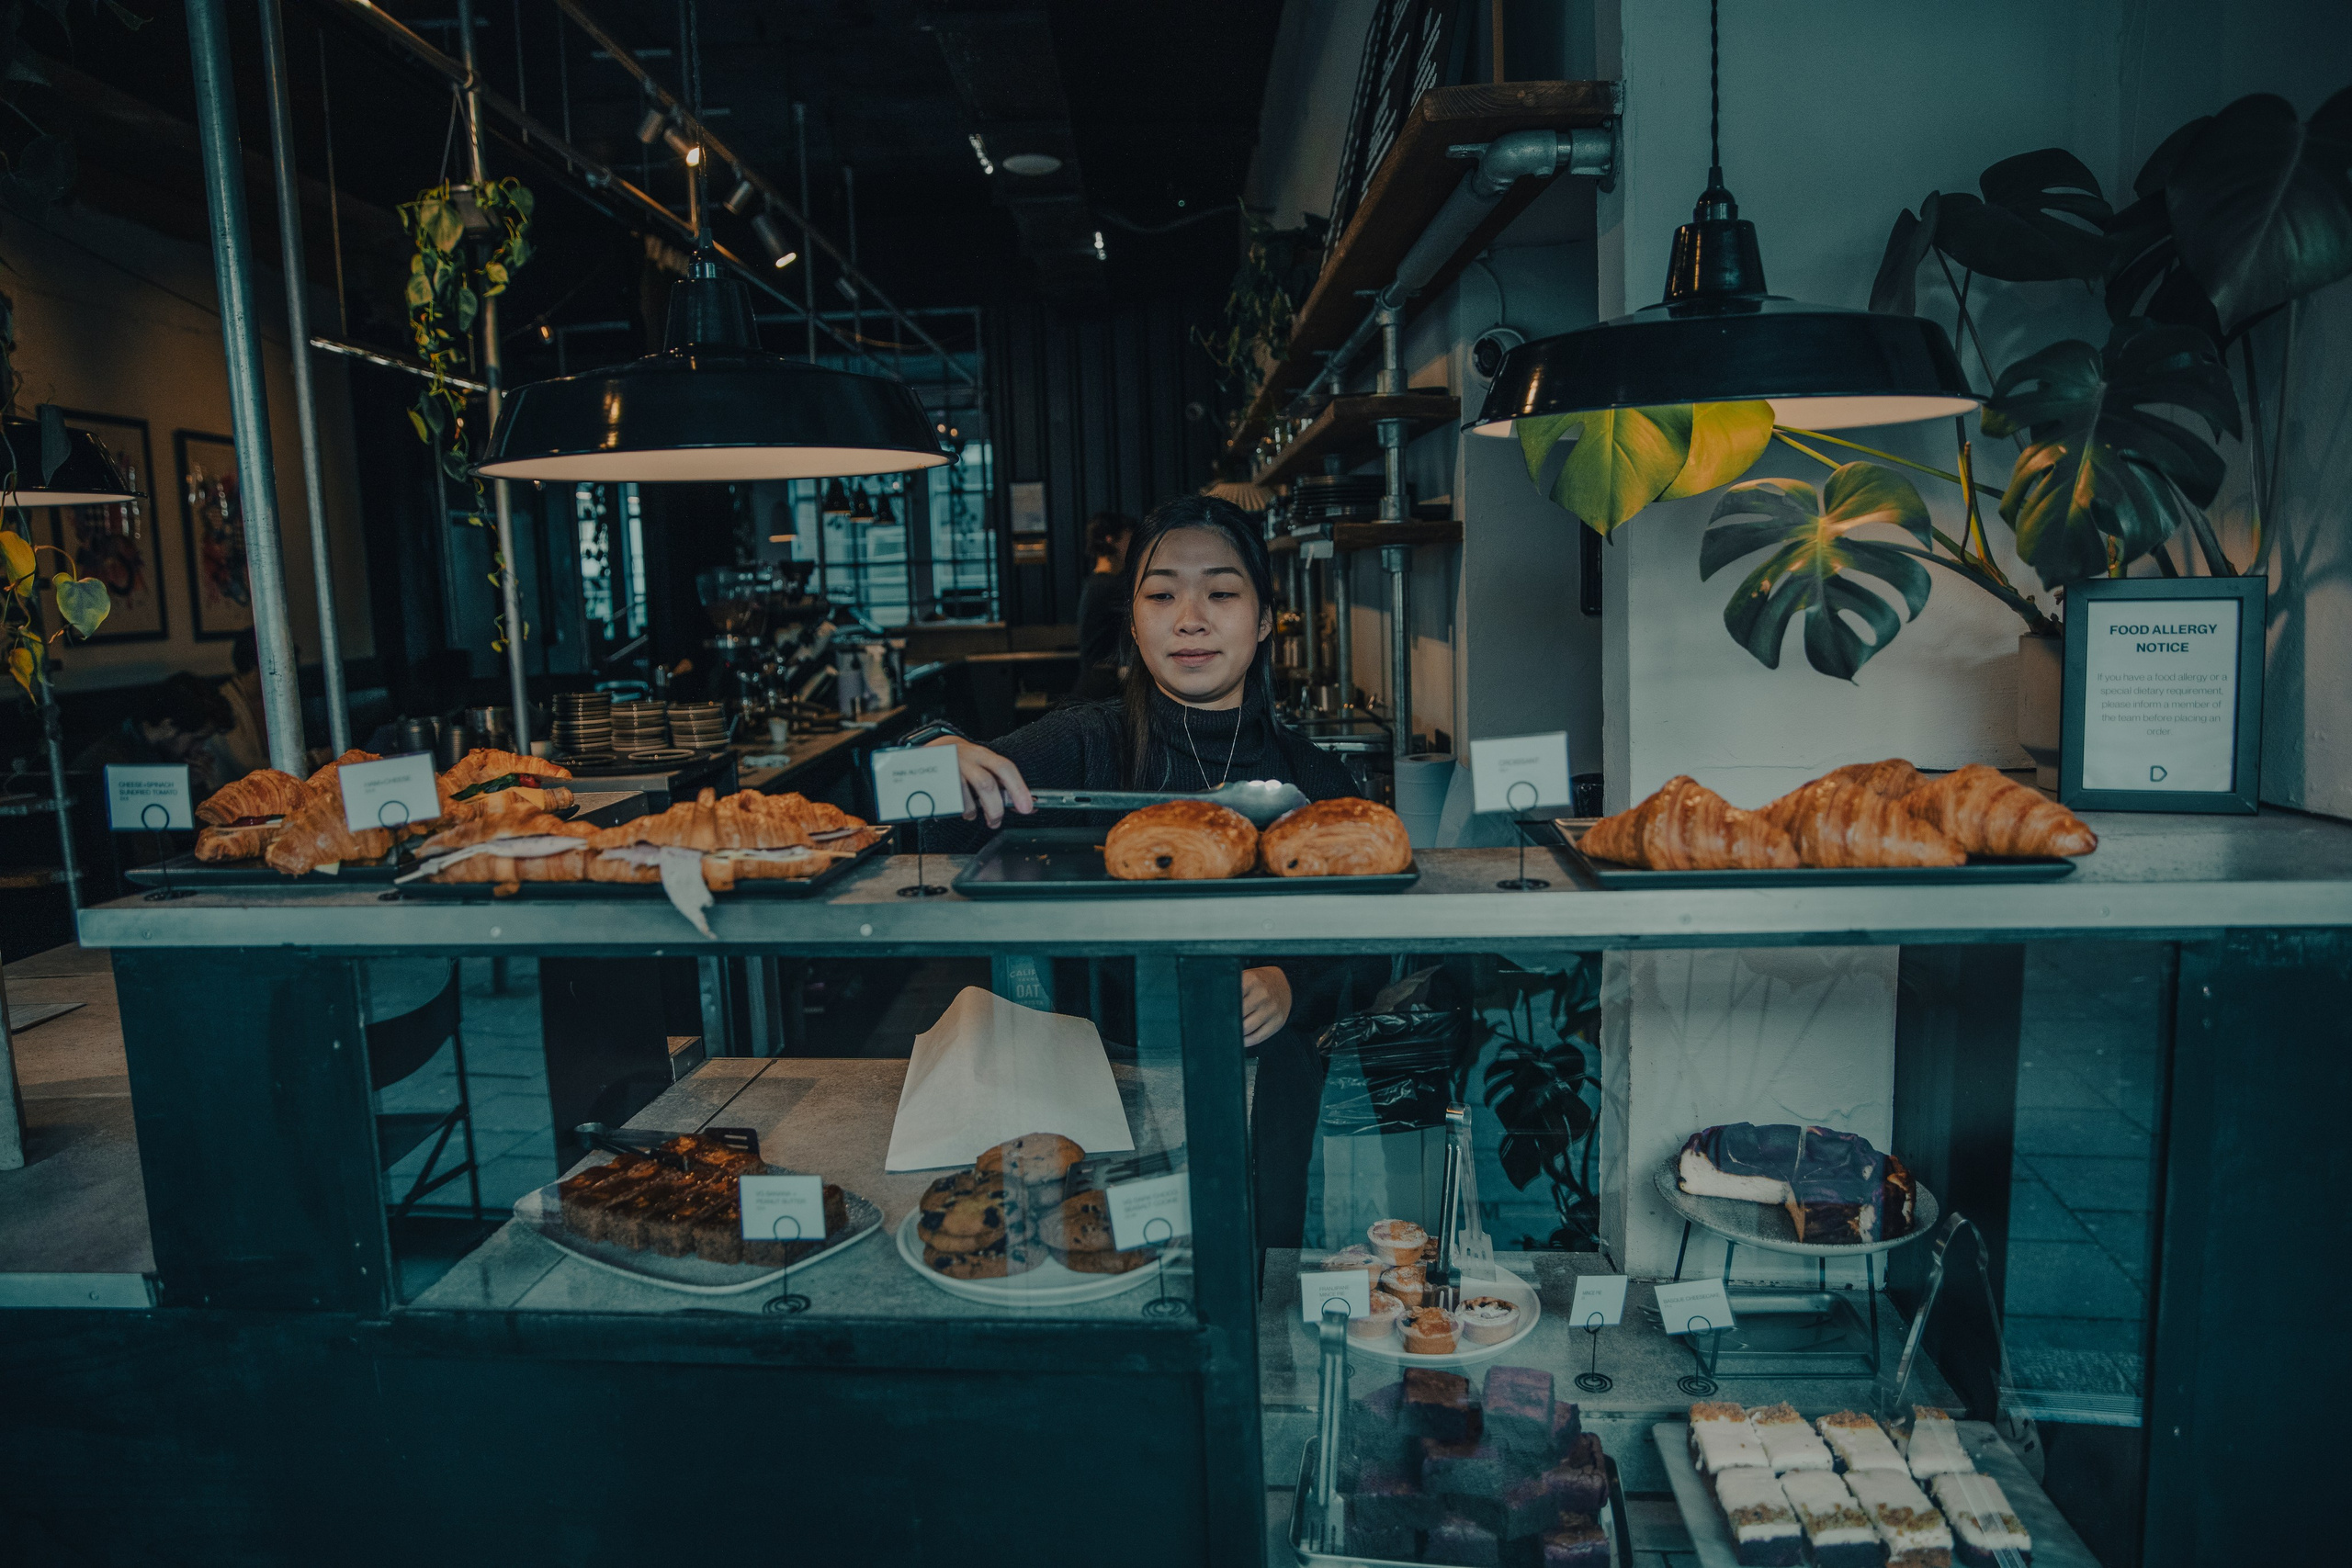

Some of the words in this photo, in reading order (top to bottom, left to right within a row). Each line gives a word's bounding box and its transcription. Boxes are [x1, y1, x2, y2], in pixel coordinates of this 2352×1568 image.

[2109, 625, 2150, 635] FOOD
[2152, 624, 2218, 635] ALLERGY
[2136, 642, 2189, 653] NOTICE
[2097, 672, 2103, 682] If
[2105, 675, 2121, 684] you
[2123, 672, 2145, 682] have
[2154, 672, 2177, 682] food
[2178, 672, 2209, 684] allergy
[2100, 686, 2132, 697] special
[2133, 686, 2165, 697] dietary
[2101, 700, 2132, 711] please
[2132, 700, 2162, 709] inform
[2171, 700, 2211, 709] member
[2211, 700, 2222, 709] of
[2101, 713, 2117, 722] the
[2118, 714, 2142, 722] team
[2143, 713, 2173, 722] before
[2174, 713, 2208, 724] placing
[2146, 726, 2173, 736] order.
[1010, 968, 1036, 978] CALIF
[1016, 984, 1040, 998] OAT
[1663, 1296, 1685, 1304] BASQUE
[1685, 1292, 1721, 1302] CHEESECAKE
